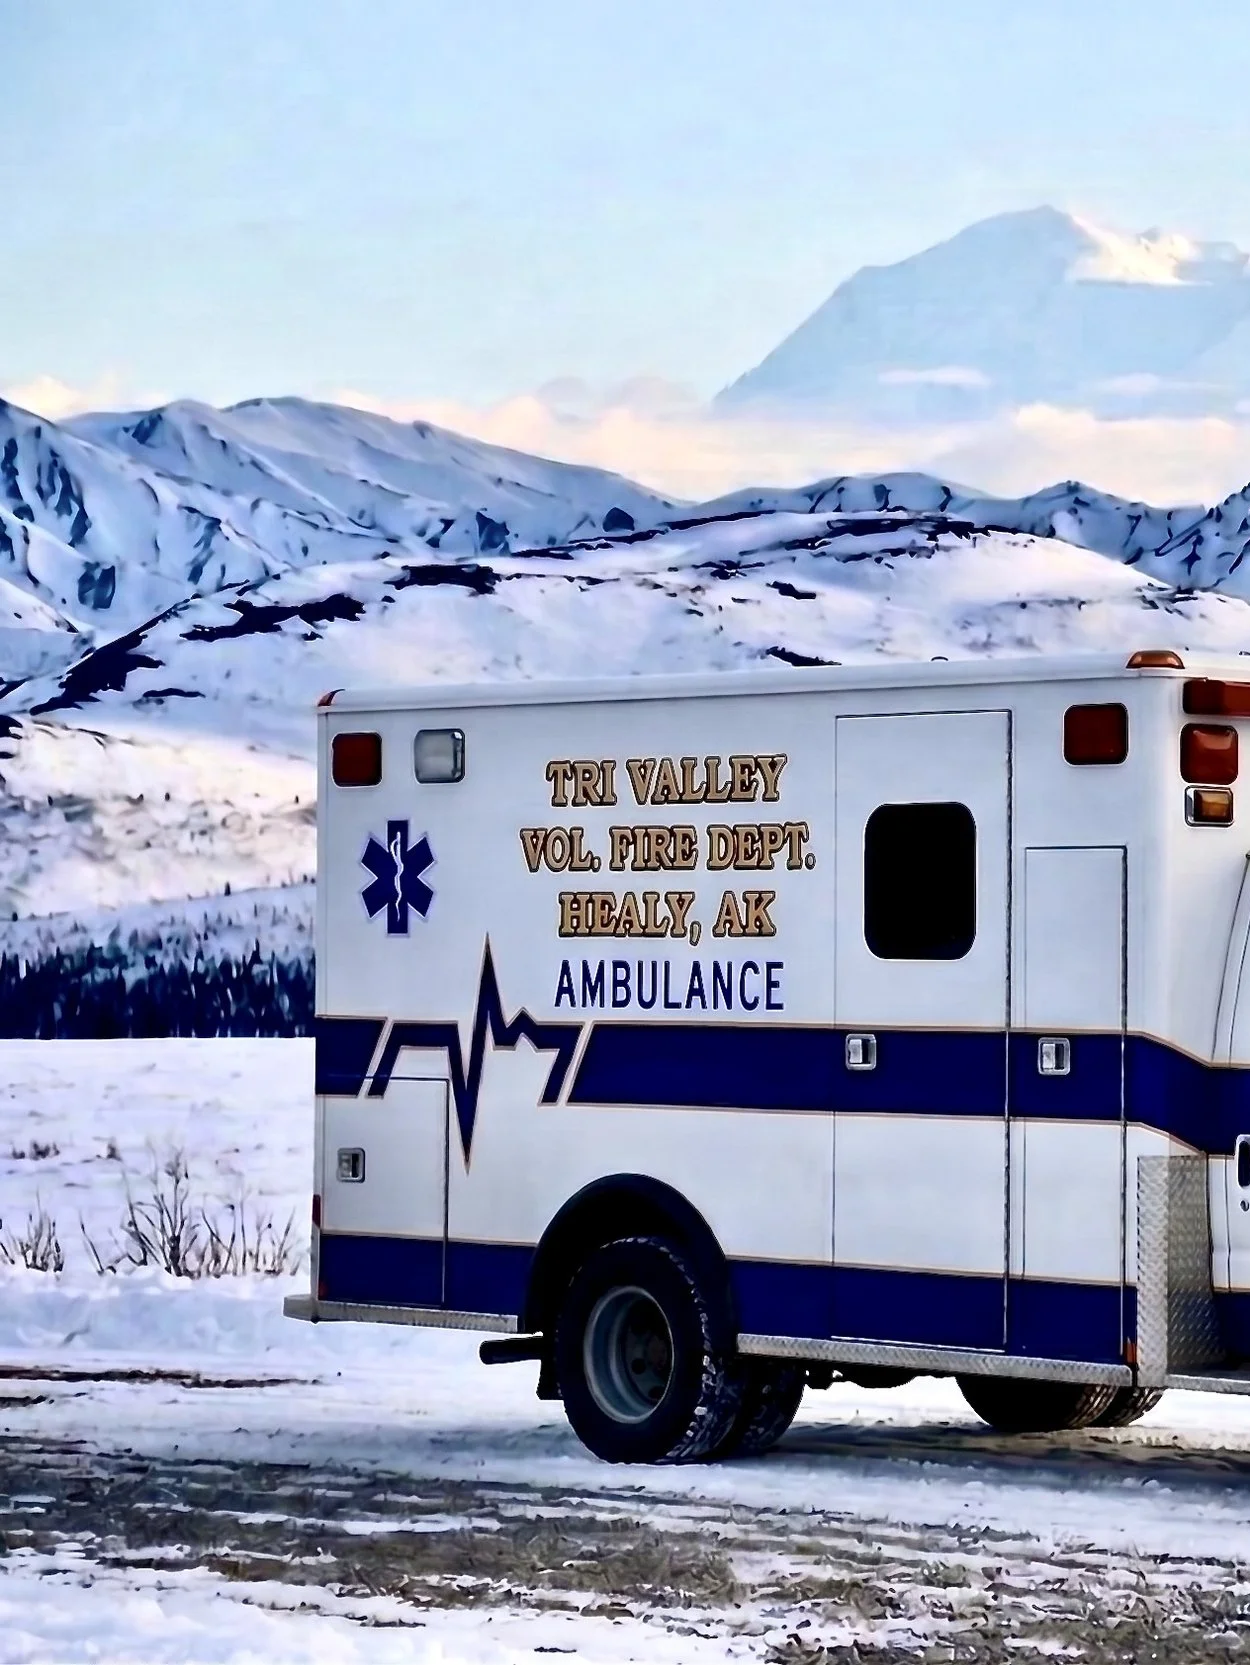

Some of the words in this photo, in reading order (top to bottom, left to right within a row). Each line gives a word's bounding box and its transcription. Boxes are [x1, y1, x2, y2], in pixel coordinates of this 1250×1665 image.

[546, 760, 617, 806] TRI
[626, 754, 787, 805] VALLEY
[520, 827, 601, 872] VOL.
[609, 825, 698, 871] FIRE
[707, 822, 816, 871] DEPT.
[558, 891, 701, 946] HEALY,
[712, 891, 776, 938] AK
[554, 960, 784, 1011] AMBULANCE
